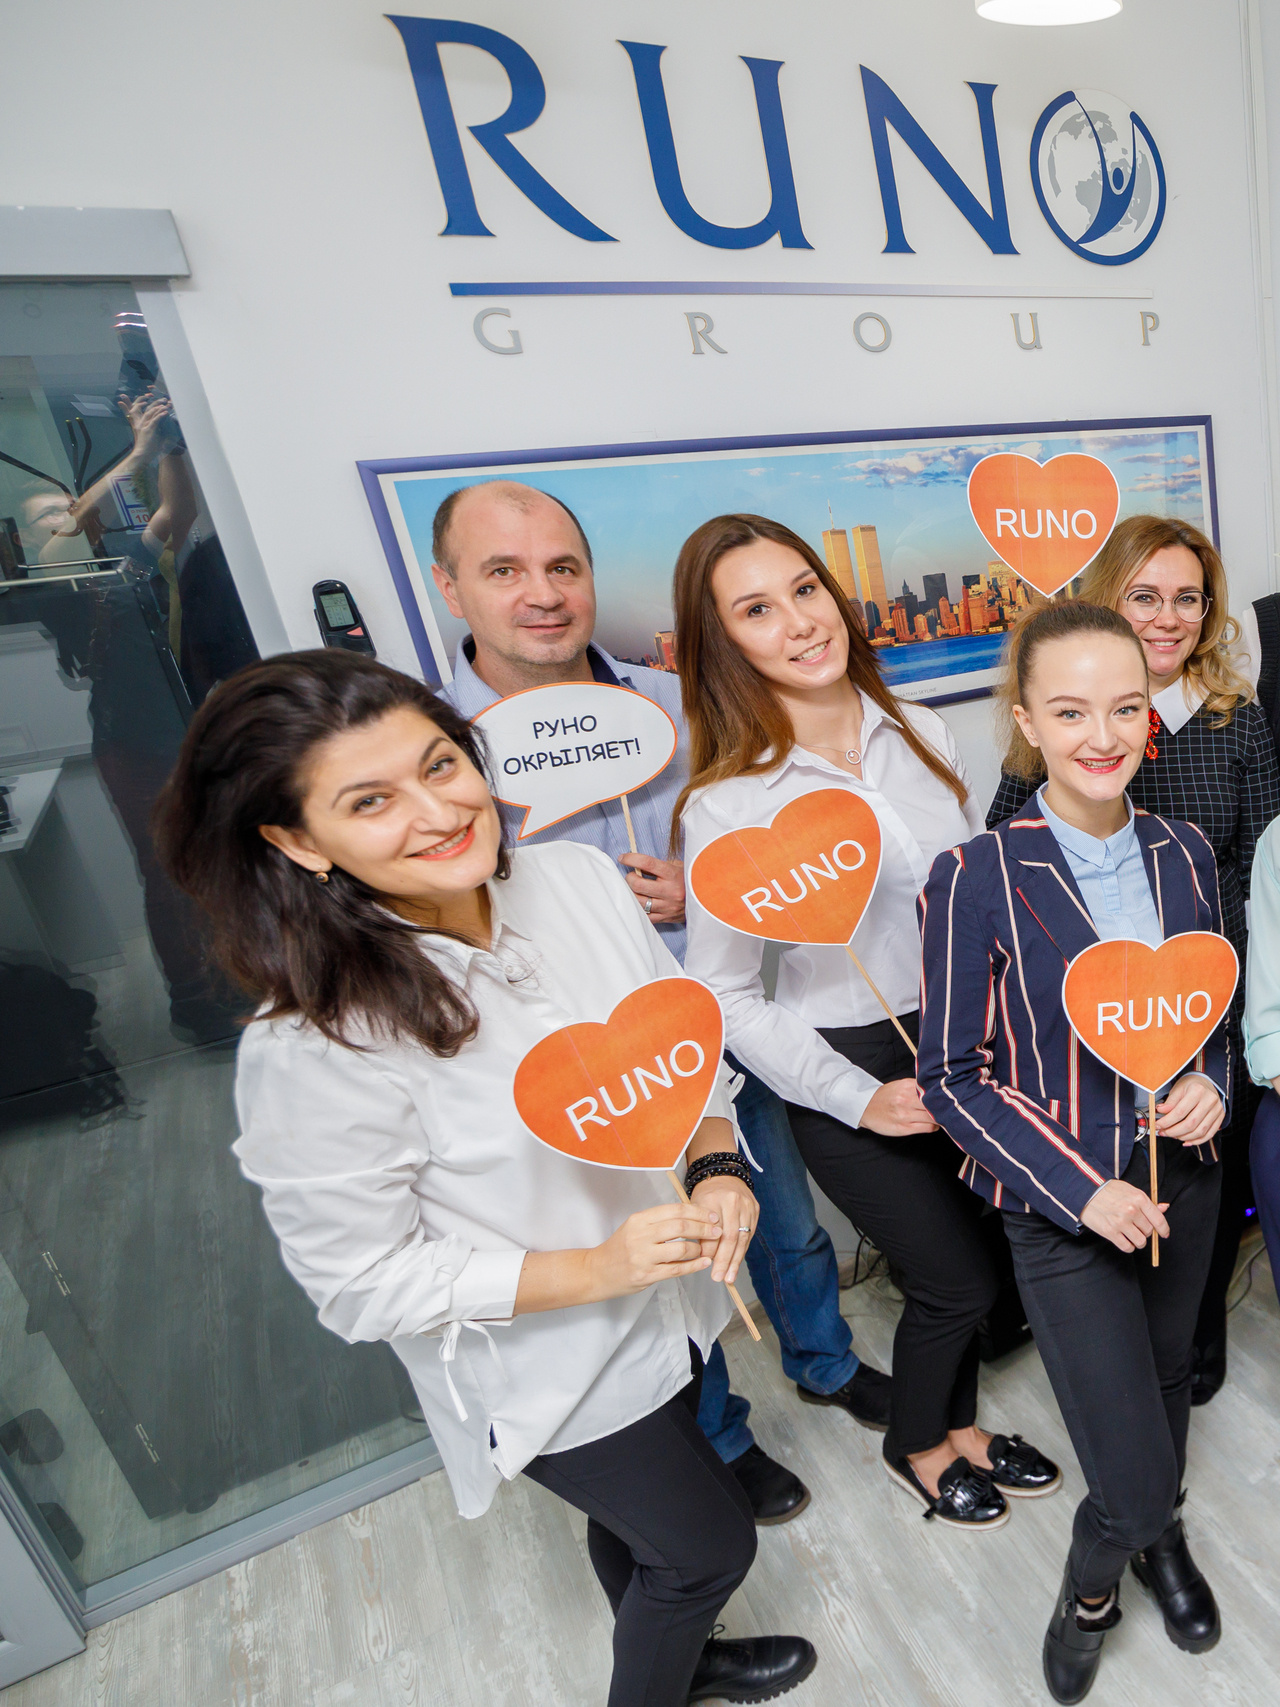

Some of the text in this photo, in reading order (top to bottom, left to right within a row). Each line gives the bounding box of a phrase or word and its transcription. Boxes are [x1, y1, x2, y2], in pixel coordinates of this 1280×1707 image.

[382, 12, 1167, 267] RUNO
[472, 306, 1161, 357] GROUP
[135, 513, 151, 523] 10
[995, 508, 1097, 540] RUNO
[918, 687, 937, 695] SKYLINE
[532, 715, 598, 740] РУНО
[503, 737, 642, 775] ОКРЫЛЯЕТ!
[740, 839, 866, 923] RUNO
[1097, 990, 1212, 1036] RUNO
[565, 1039, 705, 1142] RUNO
